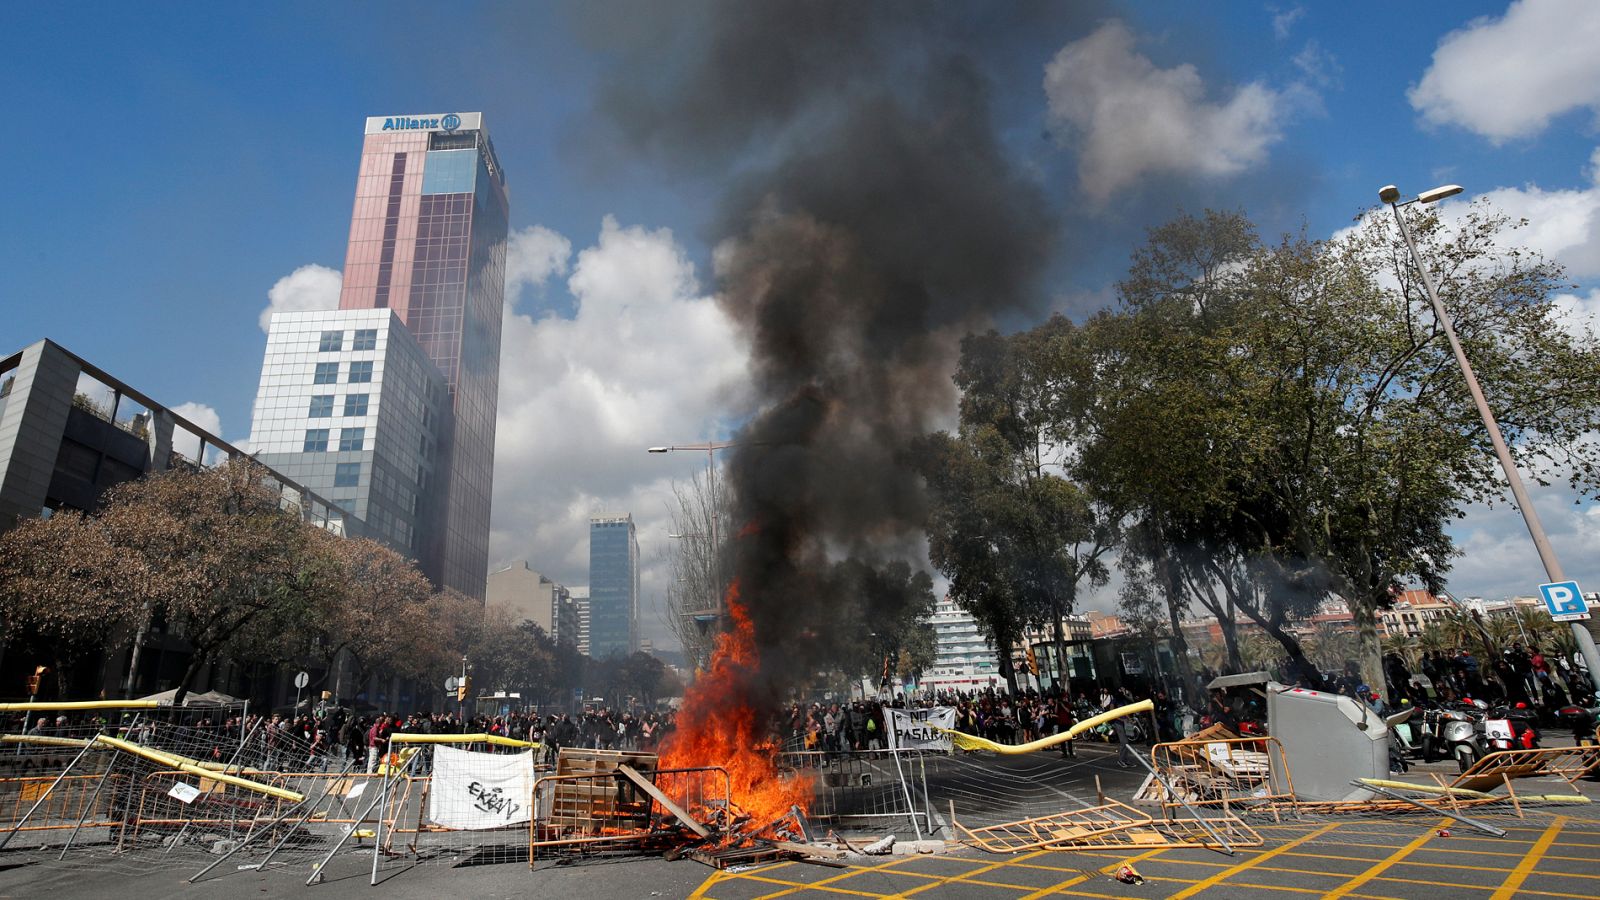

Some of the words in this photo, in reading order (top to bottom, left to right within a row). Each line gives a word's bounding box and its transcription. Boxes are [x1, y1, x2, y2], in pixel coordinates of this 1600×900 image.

[382, 117, 439, 131] Allianz
[1547, 586, 1573, 612] P
[910, 711, 928, 723] NO
